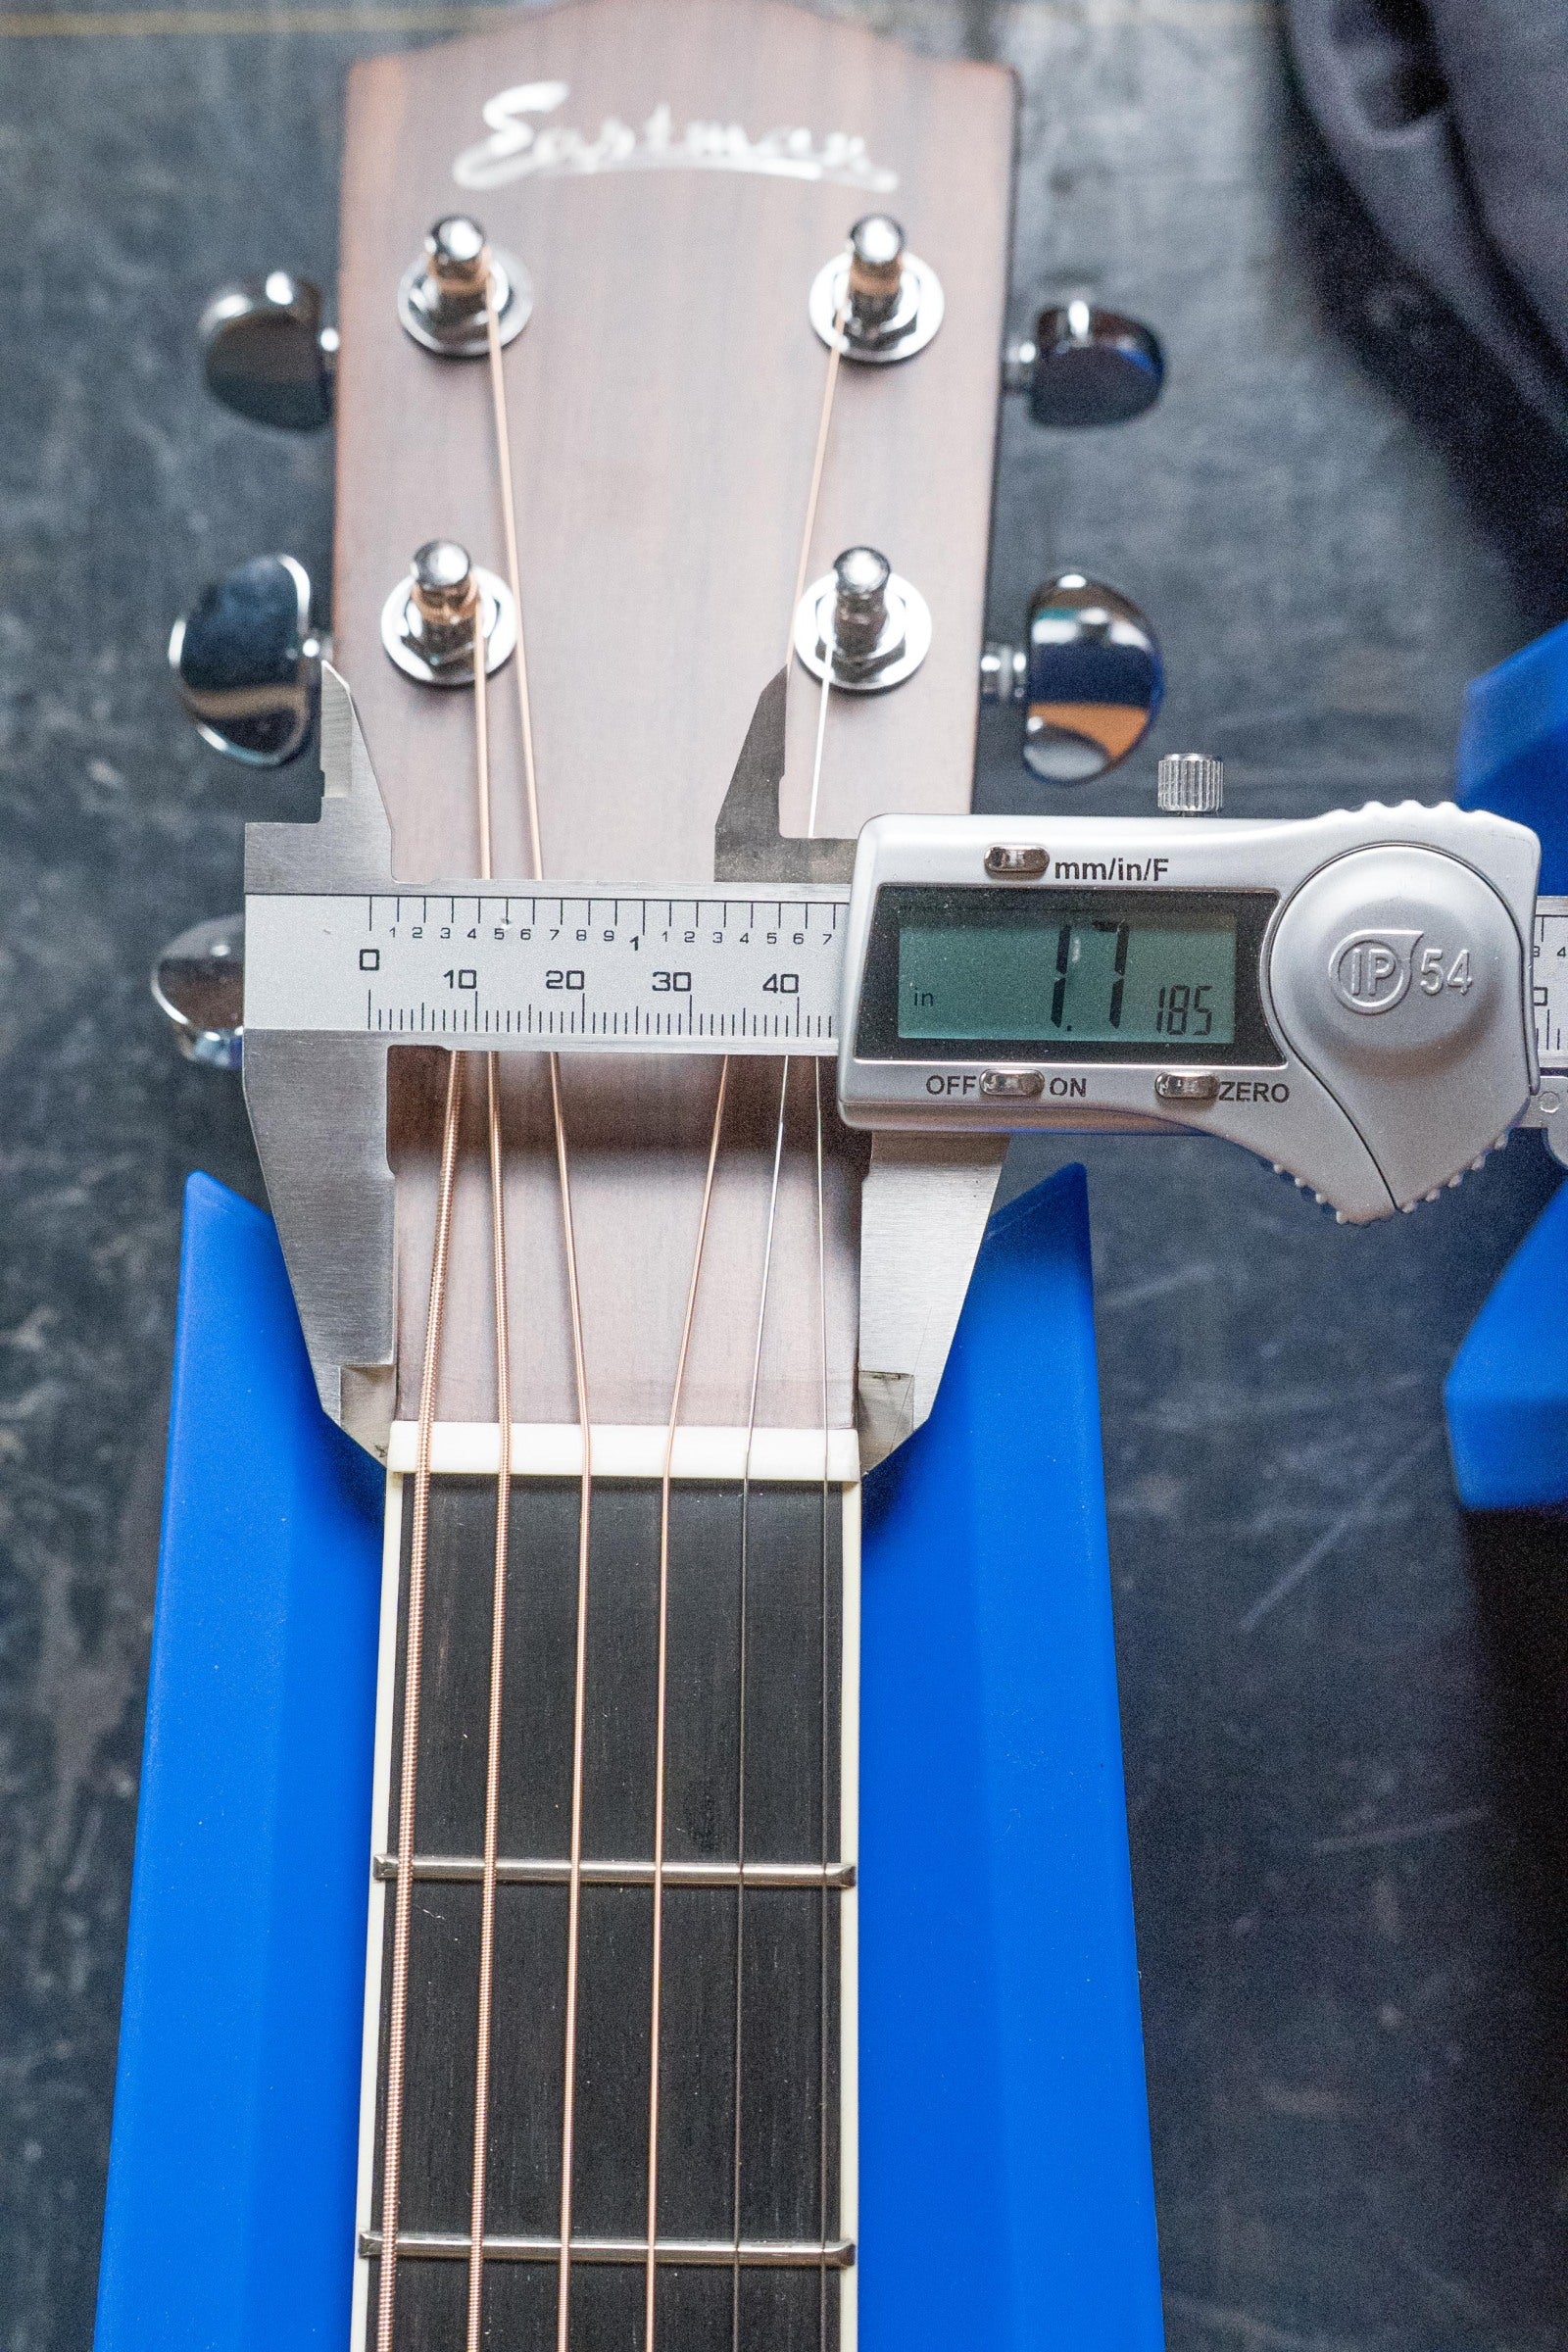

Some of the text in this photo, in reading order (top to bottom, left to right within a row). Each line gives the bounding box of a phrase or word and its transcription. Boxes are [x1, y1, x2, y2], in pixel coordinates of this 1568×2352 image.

[453, 79, 898, 193] Eastman
[1054, 858, 1170, 882] mm/in/F
[388, 926, 397, 938] 1
[412, 926, 423, 939] 2
[440, 927, 451, 940] 3
[466, 928, 478, 940] 4
[494, 927, 505, 941] 5
[519, 928, 531, 941] 6
[550, 929, 560, 941] 7
[575, 929, 587, 942] 8
[603, 929, 614, 942] 9
[629, 935, 639, 952] 1
[662, 931, 669, 943] 1
[684, 931, 696, 943] 2
[712, 931, 723, 944] 3
[739, 932, 750, 944] 4
[766, 932, 777, 945] 5
[793, 932, 805, 945] 6
[822, 933, 832, 946] 7
[1556, 946, 1567, 957] 4
[359, 948, 380, 971] 0
[443, 969, 477, 990] 10
[545, 969, 585, 991] 20
[652, 971, 692, 993] 30
[761, 973, 800, 994] 40
[1350, 948, 1472, 997] IP 54
[913, 989, 934, 1007] in
[925, 1074, 1088, 1098] OFF ON
[1218, 1081, 1291, 1103] ZERO
